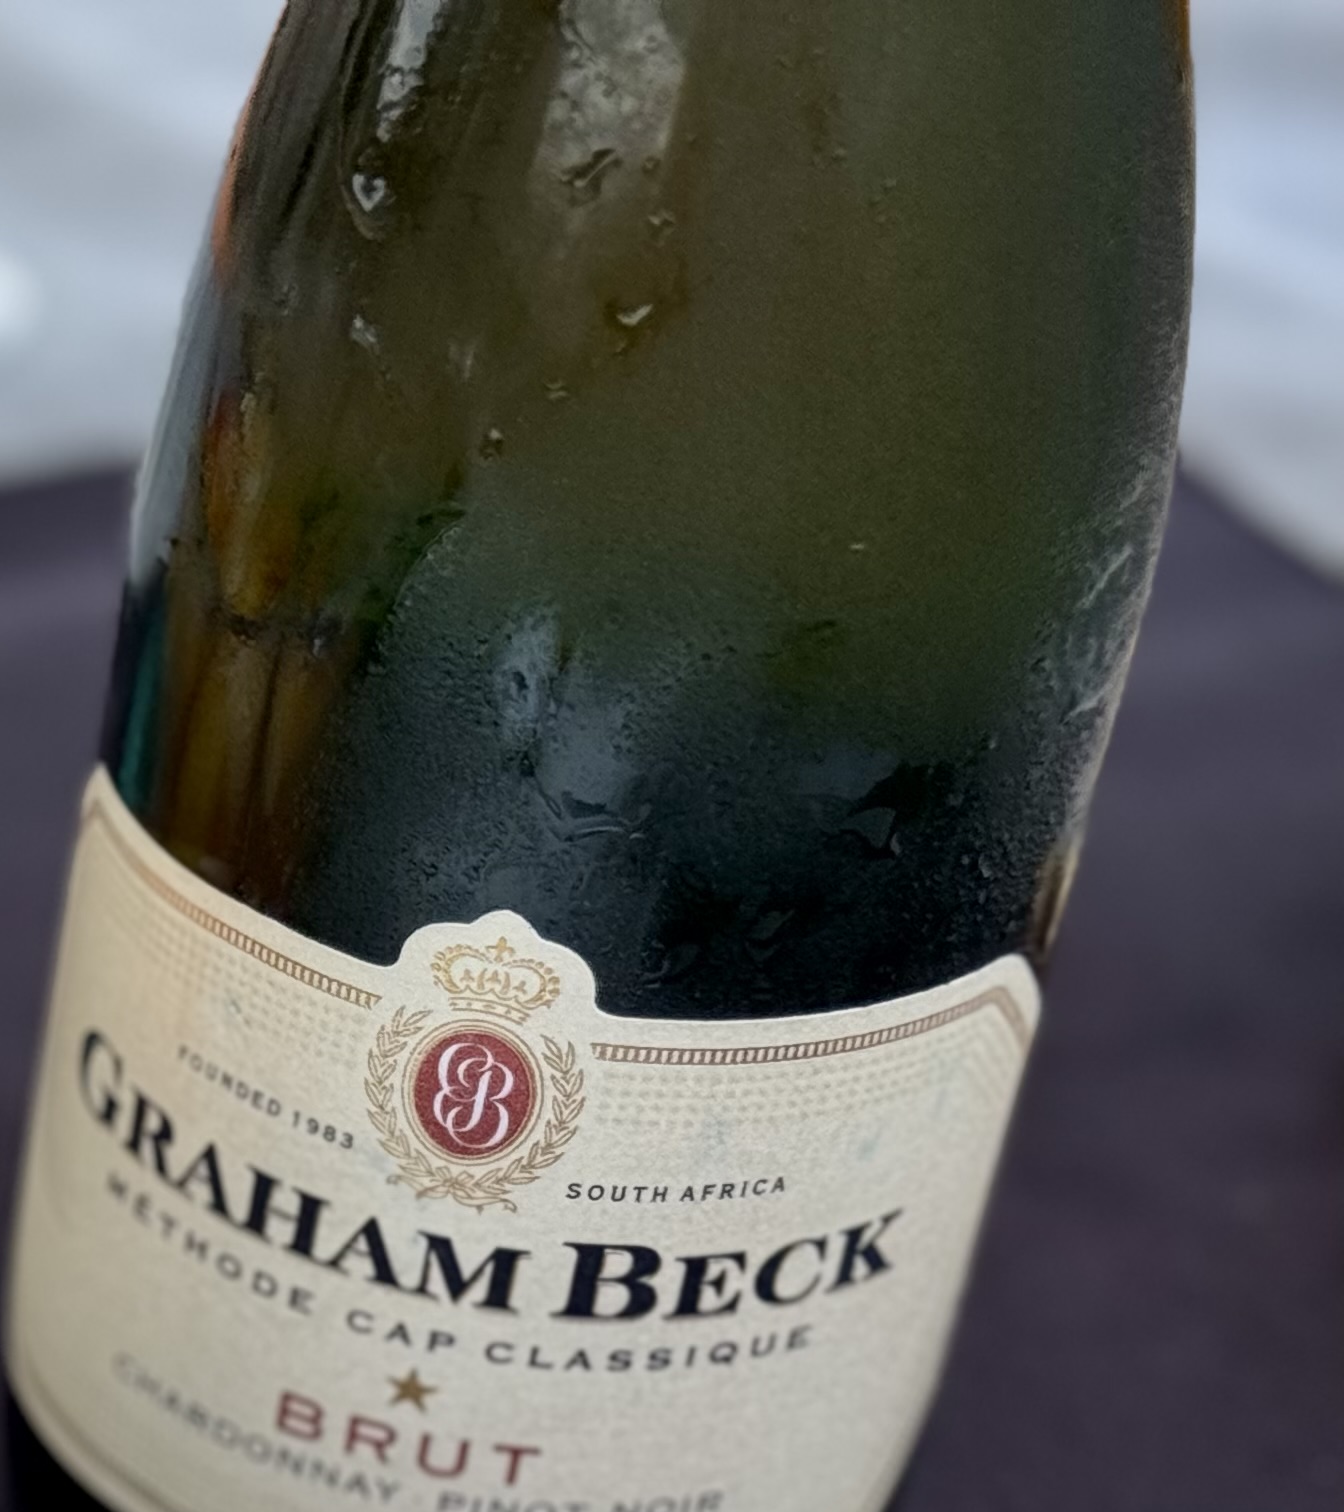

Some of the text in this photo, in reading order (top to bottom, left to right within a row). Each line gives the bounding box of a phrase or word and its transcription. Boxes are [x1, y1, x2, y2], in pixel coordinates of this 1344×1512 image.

[176, 1045, 355, 1150] FOUNDED 1983
[78, 1028, 904, 1321] GRAHAM BECK
[565, 1176, 787, 1203] SOUTH AFRICA
[345, 1309, 456, 1353] CAP
[484, 1325, 814, 1373] CLASSIQUE
[113, 1350, 400, 1504] CHARDONNAY
[275, 1389, 543, 1488] BRUT
